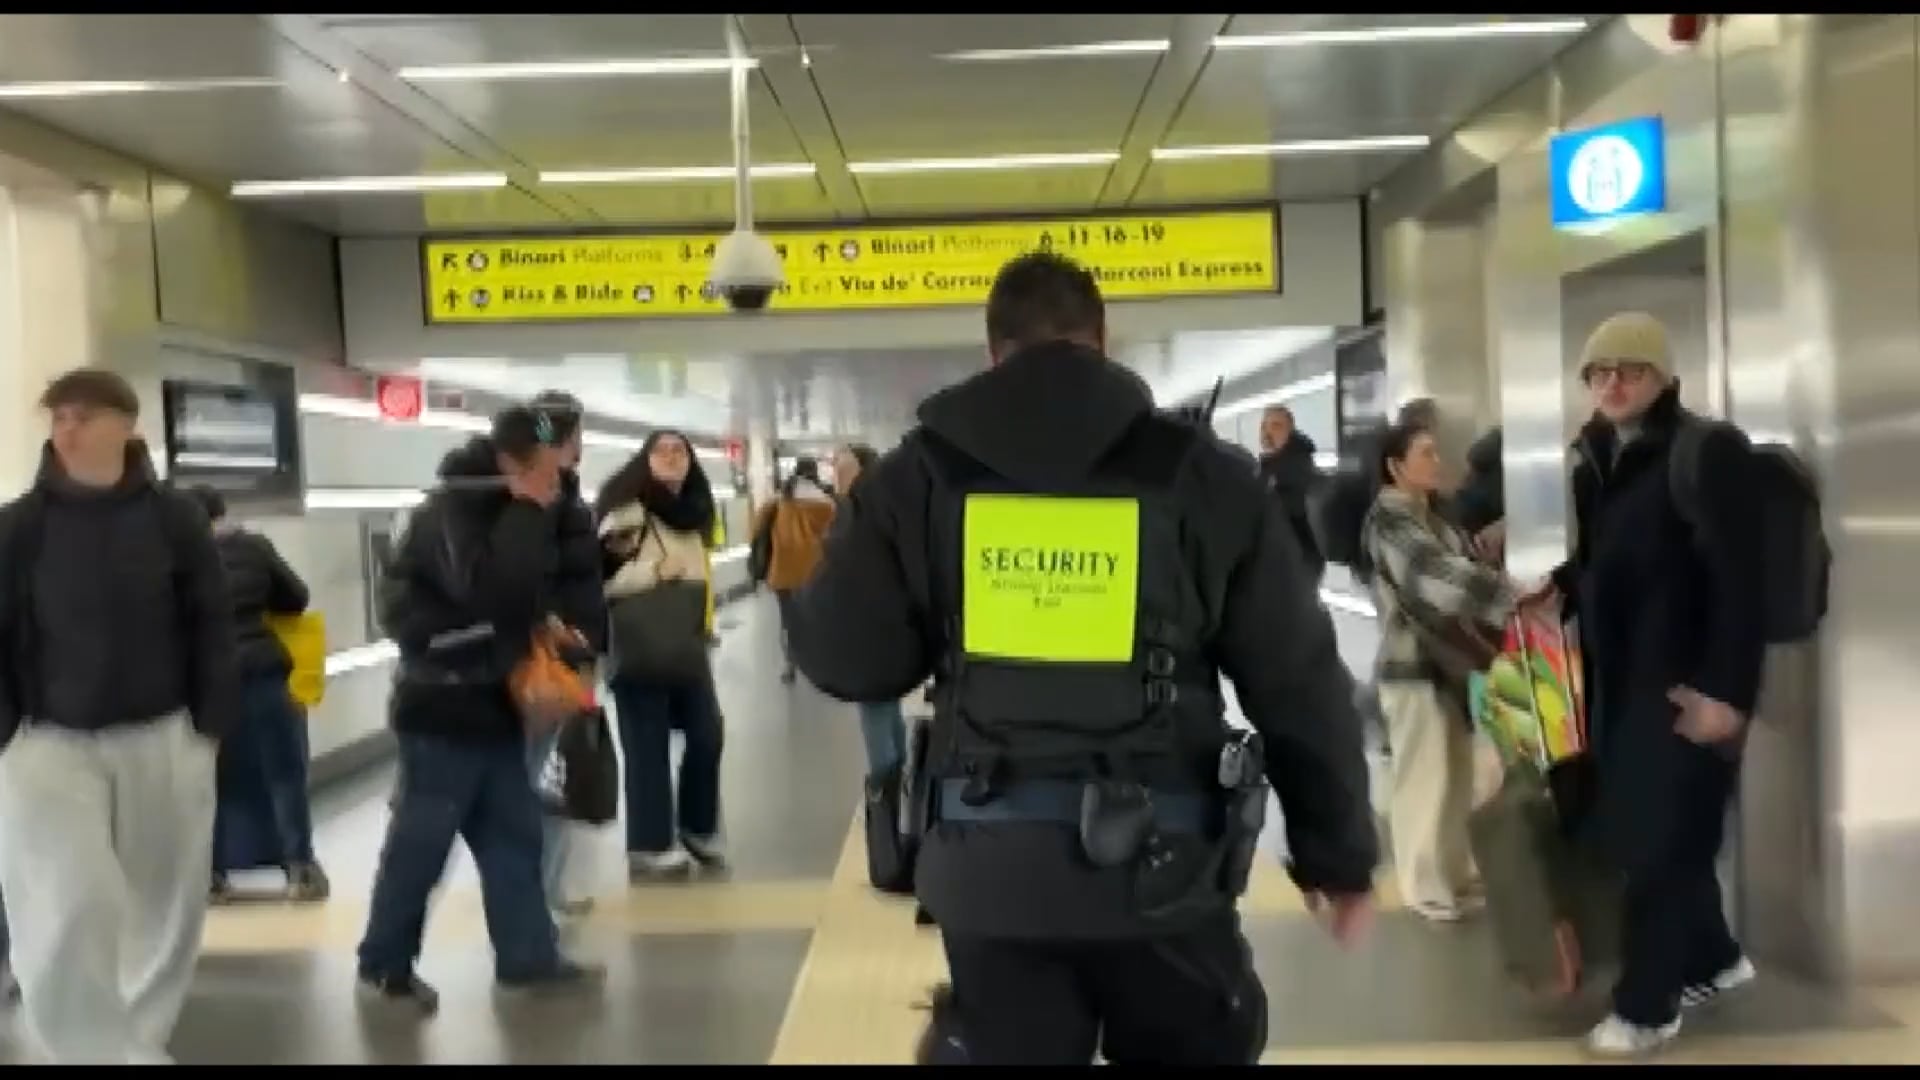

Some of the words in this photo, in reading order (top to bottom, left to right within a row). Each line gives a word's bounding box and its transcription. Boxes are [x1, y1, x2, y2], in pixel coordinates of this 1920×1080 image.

[871, 235, 936, 255] Binari
[500, 247, 567, 265] Binari
[1178, 260, 1264, 280] Express
[840, 275, 875, 291] Via
[981, 547, 1120, 577] SECURITY
